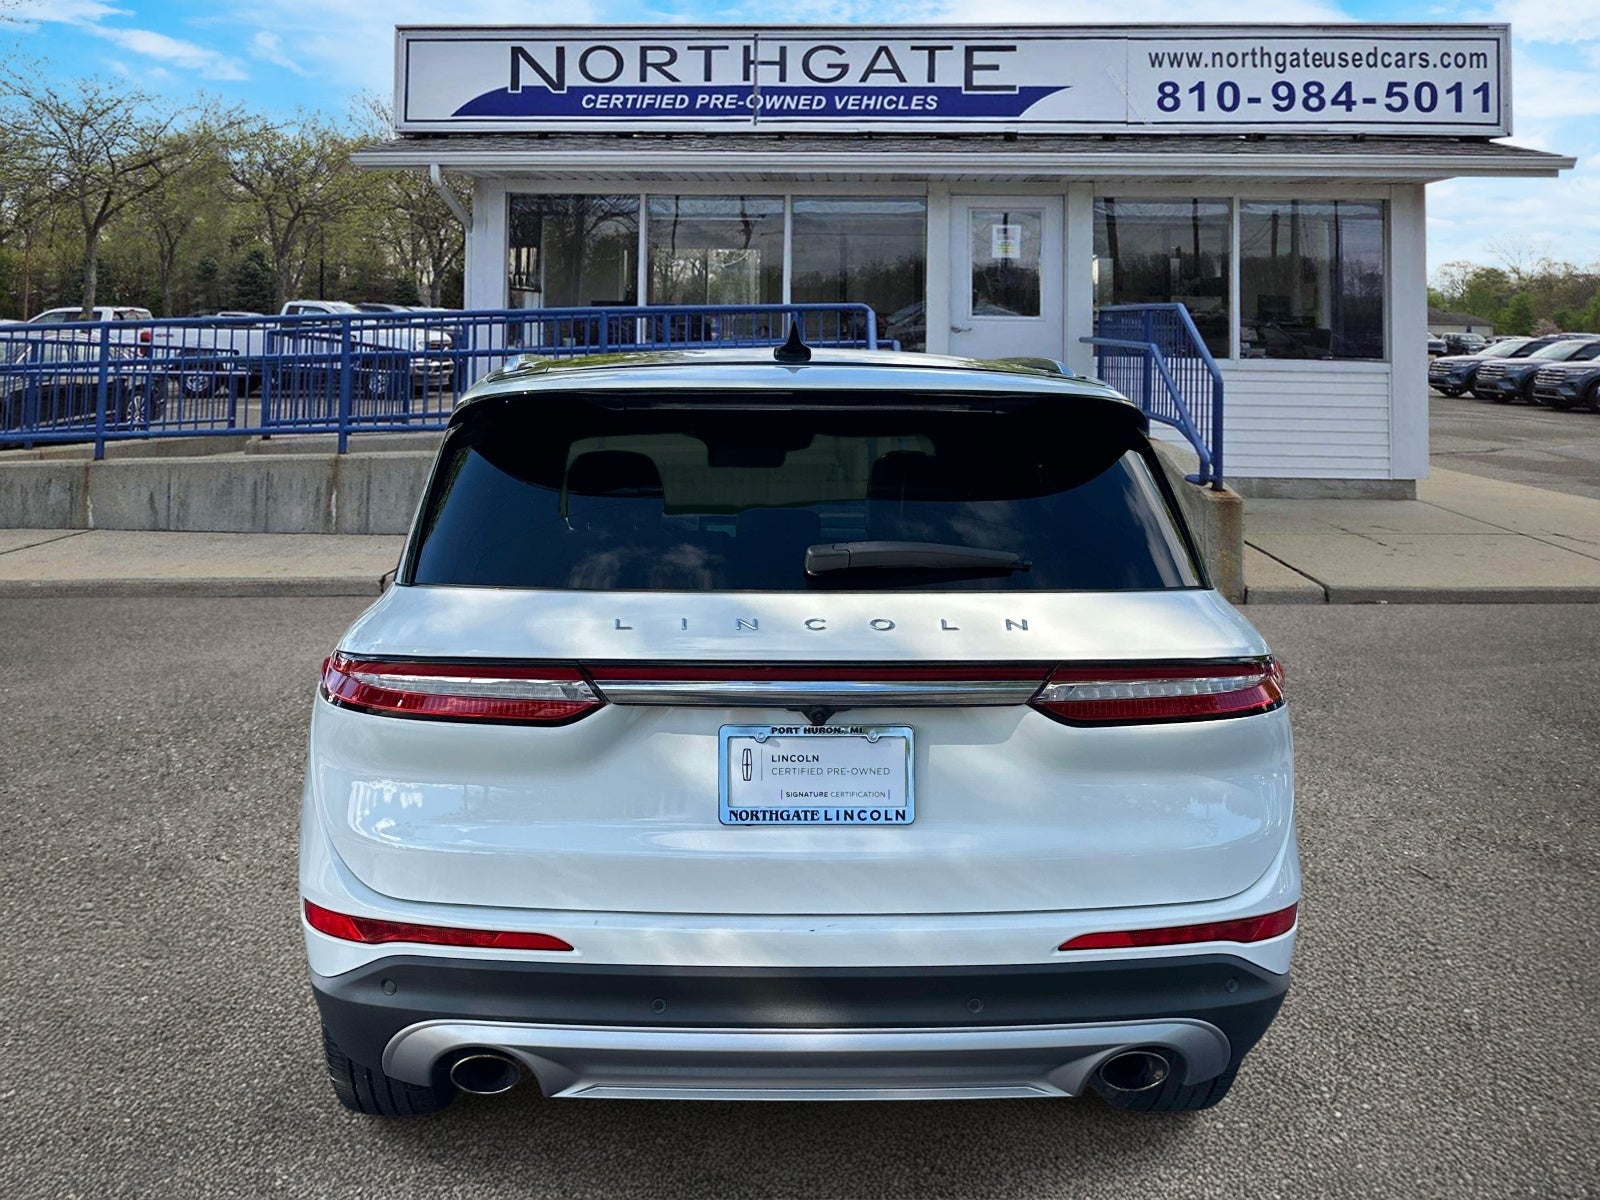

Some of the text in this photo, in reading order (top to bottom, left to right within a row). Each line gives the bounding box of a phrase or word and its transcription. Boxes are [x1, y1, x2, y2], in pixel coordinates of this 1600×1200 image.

[1149, 47, 1488, 73] www.northgateusedcars.com
[510, 45, 1017, 91] NORTHGATE
[581, 94, 938, 110] CERTIFIED PRE-OWNED VEHICLES
[1156, 80, 1490, 113] 810-984-5011
[615, 617, 1029, 631] LINCOLN
[771, 726, 800, 735] PORT
[850, 726, 863, 735] MI
[771, 755, 820, 763] LINCOLN
[771, 767, 891, 776] CERTIFIED PRE-OWNED
[729, 810, 906, 822] NORTHGATE LINCOLN
